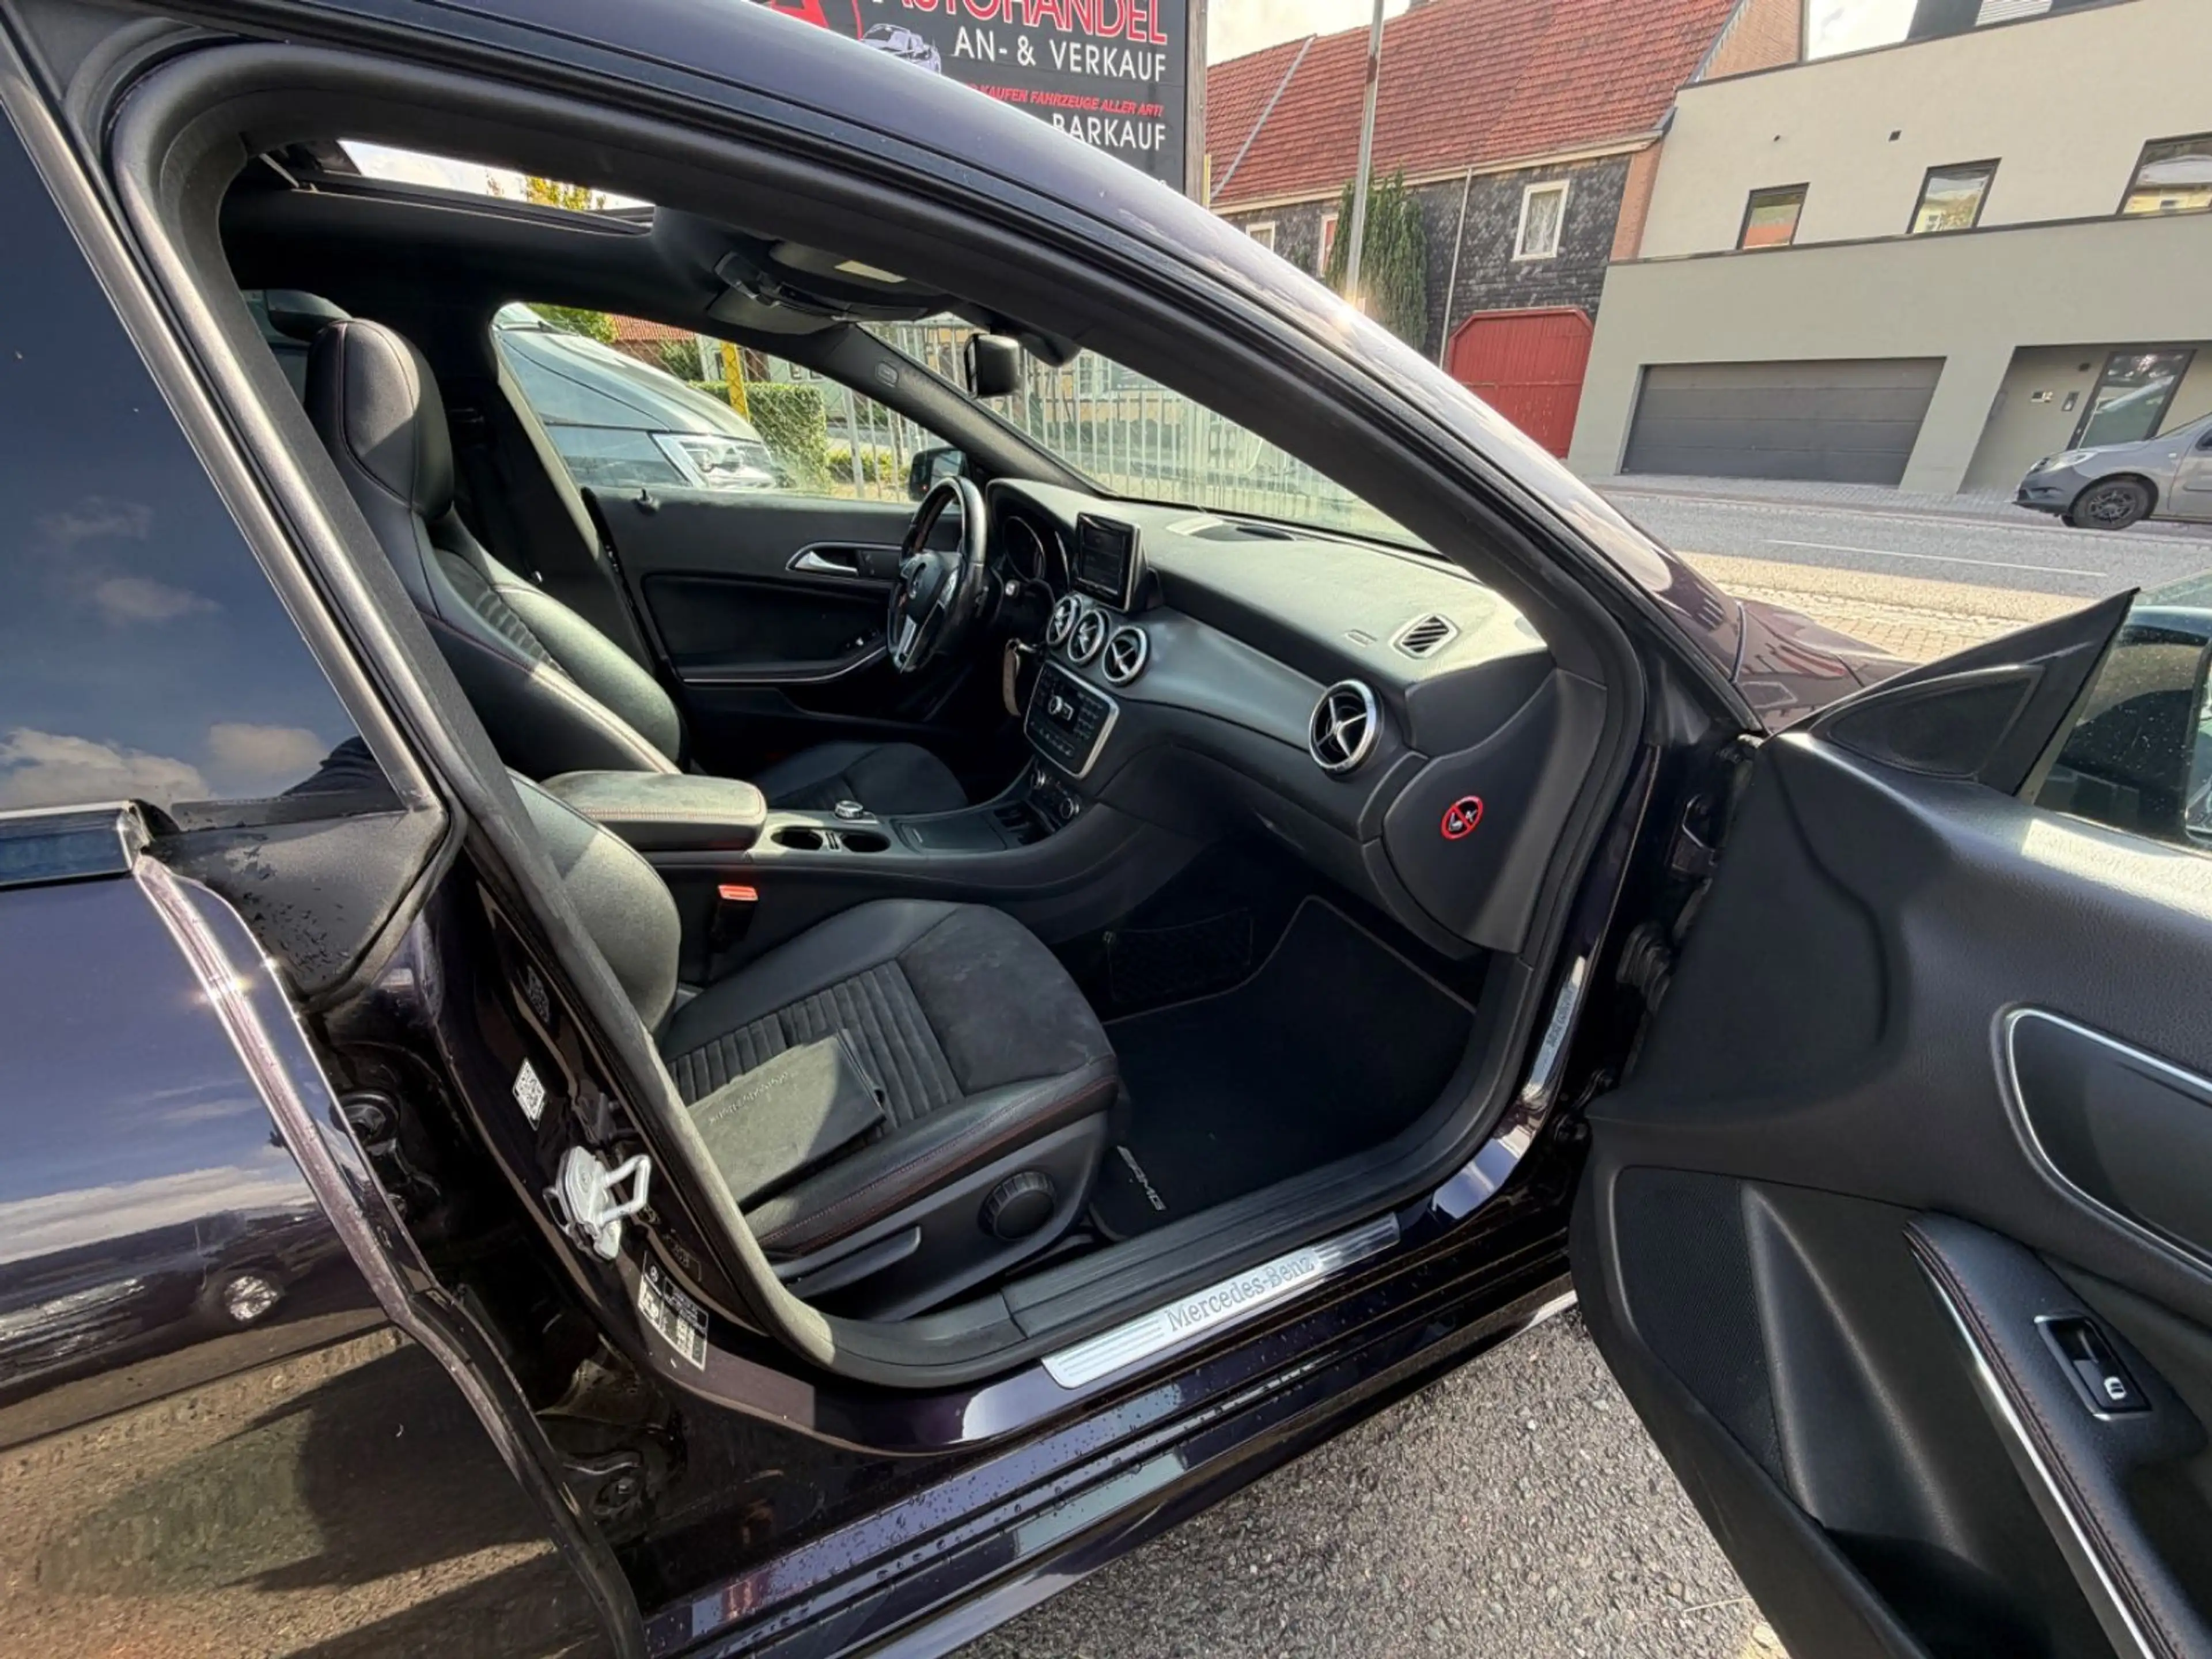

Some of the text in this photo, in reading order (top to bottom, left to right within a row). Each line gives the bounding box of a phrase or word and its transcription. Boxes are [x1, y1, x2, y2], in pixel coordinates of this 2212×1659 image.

[953, 25, 1166, 82] AN- & VERKAUF
[1031, 90, 1100, 111] FAHRZEUGE
[1100, 99, 1137, 115] ALLER
[1052, 112, 1166, 151] BARKAUF
[1165, 1256, 1315, 1332] Mercedes-Benz
